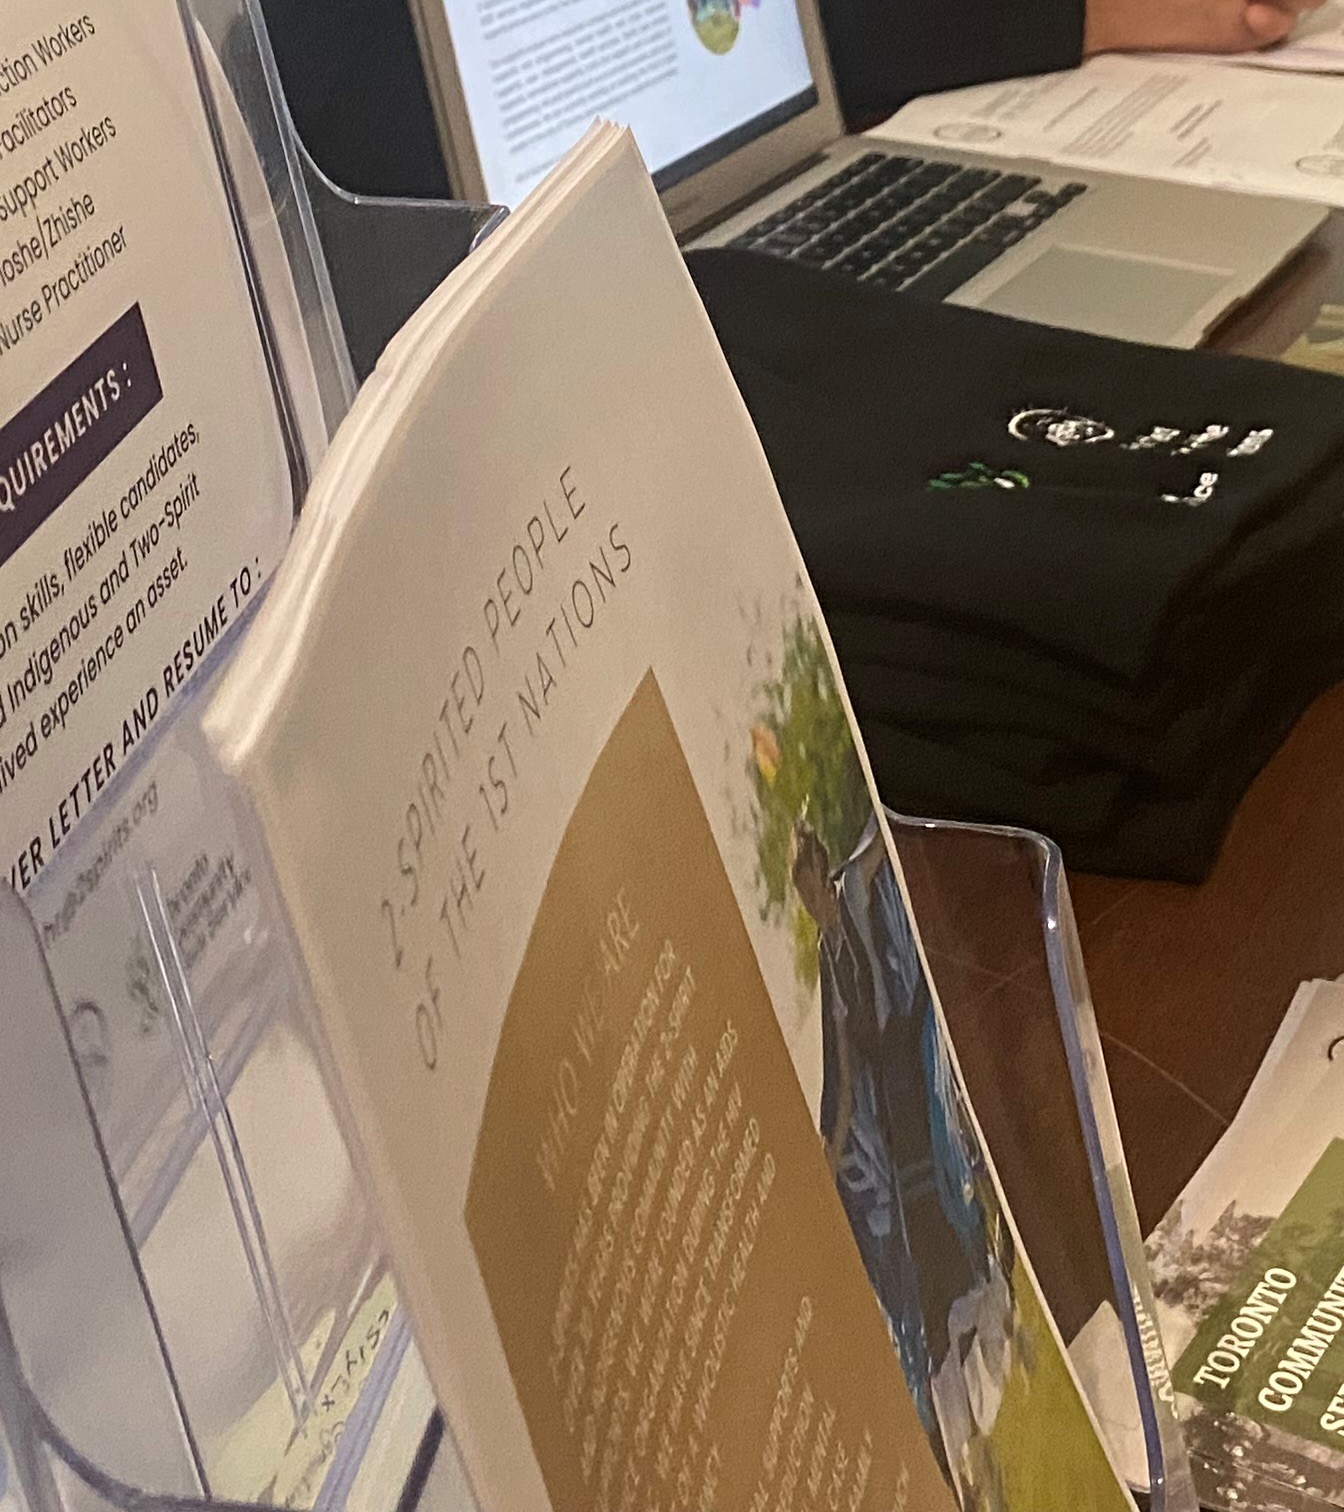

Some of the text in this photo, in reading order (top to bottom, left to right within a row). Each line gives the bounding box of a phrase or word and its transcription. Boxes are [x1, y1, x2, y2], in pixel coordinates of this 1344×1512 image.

[32, 12, 96, 69] Workers
[54, 114, 117, 175] Workers
[42, 226, 129, 311] Practitioner
[6, 598, 98, 708] Indigenous
[99, 563, 131, 604] and
[130, 471, 201, 570] Two-Spirit
[19, 572, 65, 633] skills,
[64, 511, 119, 582] flexible
[121, 421, 201, 519] candidates,
[482, 465, 588, 656] PEOPLE
[39, 621, 124, 732] experience
[124, 603, 149, 635] an
[146, 551, 189, 608] asset.
[50, 742, 117, 851] LETTER
[122, 686, 160, 757] AND
[163, 605, 231, 698] RESUME
[417, 955, 442, 1071] OF
[440, 822, 486, 962] THE
[513, 522, 633, 730] NATIONS
[1193, 1267, 1298, 1389] TORONTO
